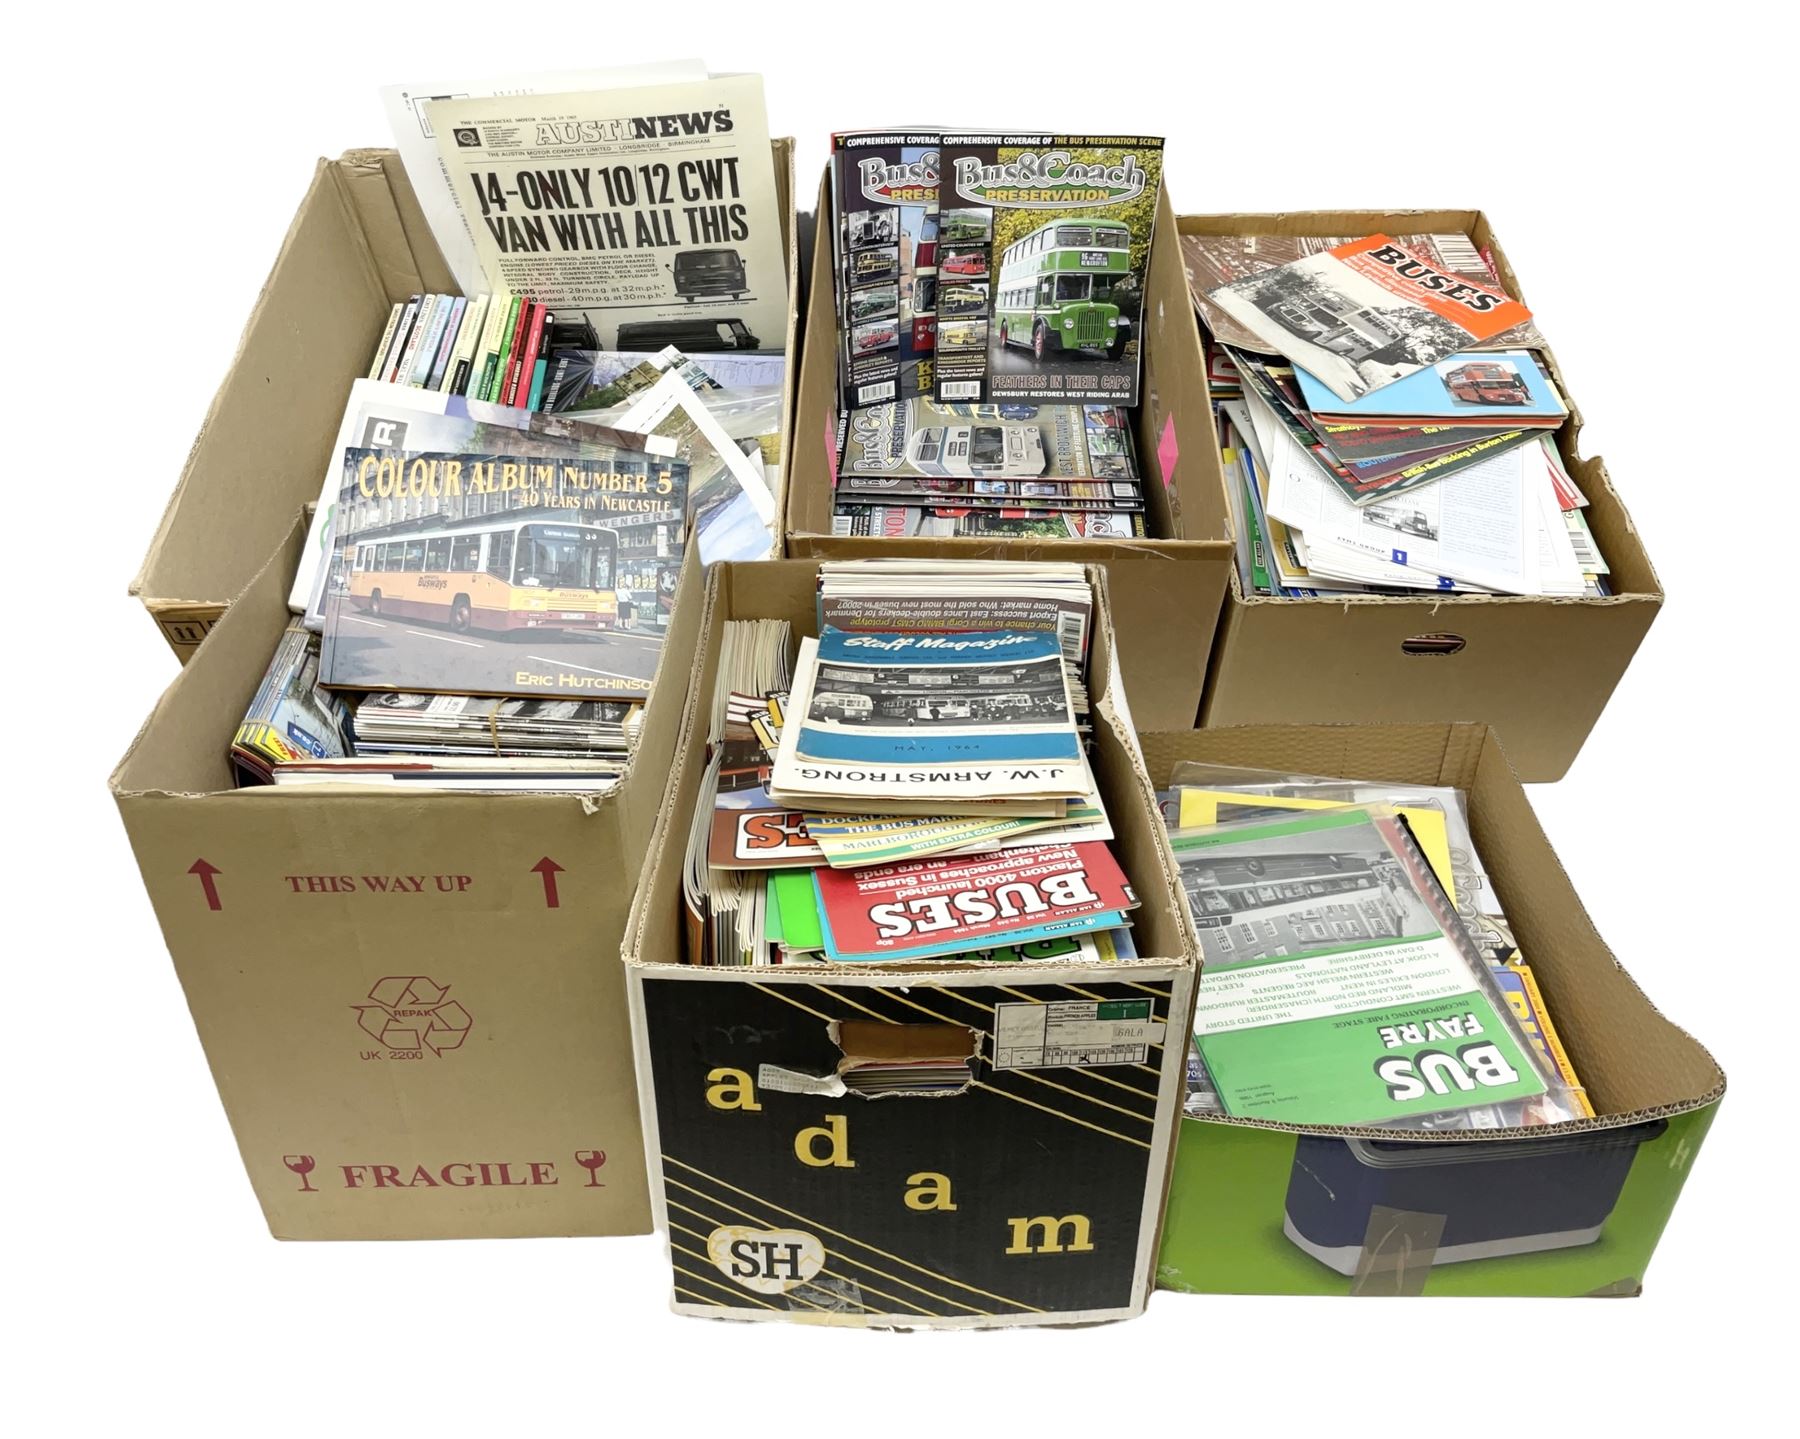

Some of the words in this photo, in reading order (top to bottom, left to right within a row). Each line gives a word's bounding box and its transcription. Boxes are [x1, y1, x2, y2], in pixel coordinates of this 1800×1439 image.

[668, 138, 710, 147] BIRMINGHAM
[847, 136, 905, 147] COMPREHENSIVE
[943, 136, 1002, 145] COMPREHENSIVE
[1003, 136, 1041, 145] COVERAGE
[1043, 136, 1052, 145] OF
[1054, 136, 1068, 145] THE
[1069, 136, 1083, 145] BUS
[1085, 137, 1137, 145] PRESERVATION
[1138, 137, 1162, 146] SCENE
[678, 157, 740, 202] CWT
[985, 189, 1110, 201] PRESERVATION
[484, 216, 551, 253] VAN
[548, 211, 628, 252] WITH
[635, 208, 680, 249] ALL
[683, 204, 748, 245] THIS
[1368, 243, 1502, 312] BUSES
[992, 375, 1047, 389] FEATHERS
[1050, 375, 1062, 389] IN
[1065, 375, 1098, 389] THEIR
[1101, 375, 1131, 389] CAPS
[1066, 390, 1085, 398] WEST
[1086, 390, 1110, 398] RIDING
[359, 455, 463, 498] COLOUR
[467, 461, 554, 496] ALBUM
[656, 471, 673, 495] 5
[520, 491, 538, 506] 40
[583, 496, 596, 510] IN
[599, 511, 675, 528] WENGERS
[417, 576, 447, 590] Busways
[837, 601, 862, 609] 2000?
[864, 601, 872, 609] in
[874, 601, 899, 609] buses
[920, 601, 941, 609] most
[946, 601, 957, 609] the
[959, 601, 976, 609] sold
[979, 601, 997, 609] Who
[1000, 601, 1030, 610] market:
[1033, 602, 1057, 610] Home
[825, 610, 861, 618] Denmark
[864, 610, 875, 618] for
[878, 609, 940, 618] double-deckers
[943, 610, 967, 618] Lancs
[970, 610, 987, 618] East
[990, 610, 1026, 619] success:
[1029, 610, 1056, 619] Export
[850, 617, 889, 626] prototype
[918, 619, 943, 627] BMMO
[945, 617, 968, 627] Corgi
[977, 620, 992, 628] win
[995, 620, 1003, 628] to
[1005, 620, 1034, 629] chance
[1037, 621, 1056, 630] Your
[843, 635, 915, 650] Staff
[947, 743, 981, 751] 1964
[794, 766, 992, 783] ARMSTRONG.
[1004, 769, 1065, 781] J.W.
[845, 820, 879, 835] THE
[882, 818, 914, 832] BUS
[910, 839, 937, 852] WITH
[1036, 848, 1076, 863] New
[897, 862, 925, 872] era
[928, 859, 946, 870] an
[937, 856, 1033, 880] approaches
[1018, 858, 1082, 878] Plaxton
[853, 866, 892, 881] ends
[920, 871, 935, 882] in
[975, 870, 1016, 887] 4000
[285, 874, 356, 894] THIS
[361, 874, 426, 893] WAY
[435, 874, 473, 893] UP
[856, 873, 916, 891] Sussex
[895, 879, 972, 900] launched
[867, 869, 1099, 938] BUSES
[1054, 905, 1077, 915] ALLAN
[1045, 920, 1069, 930] ALLAN
[1395, 944, 1424, 954] D-DAY
[1327, 950, 1382, 964] DERBYSHIRE
[1393, 957, 1404, 965] AT
[1406, 953, 1430, 963] LOOK
[1239, 962, 1305, 978] PRESERVATION
[1350, 959, 1392, 971] LEYLAND
[1294, 965, 1349, 980] NATIONALS
[1349, 967, 1393, 980] WESTERN
[1409, 967, 1450, 980] LONDON
[1296, 979, 1315, 988] AEC
[1317, 974, 1349, 985] WELSH
[1376, 974, 1407, 985] EXILES
[1216, 981, 1244, 991] FLEET
[1251, 982, 1295, 995] REGENTS
[1339, 981, 1364, 990] KENT
[1369, 982, 1412, 995] MIDLAND
[1416, 983, 1461, 996] WESTERN
[1247, 988, 1316, 1004] ROUTEMASTER
[1313, 992, 1345, 1003] NORTH
[1347, 989, 1367, 998] RED
[1395, 991, 1415, 1000] SMT
[1334, 994, 1394, 1009] CONDUCTOR
[393, 1008, 432, 1017] REPAK
[1390, 1000, 1468, 1017] INCORPORATING
[1237, 1012, 1273, 1024] UNITED
[1275, 1010, 1292, 1019] THE
[1365, 1012, 1389, 1022] FARE
[1204, 1019, 1236, 1029] STORY
[1332, 1017, 1363, 1028] STAGE
[1375, 1010, 1484, 1050] FAYRE
[359, 1051, 381, 1060] UK
[389, 1050, 423, 1060] 2200
[1371, 1037, 1519, 1103] BUS
[336, 1161, 559, 1190] FRAGILE
[730, 1240, 804, 1281] SH
